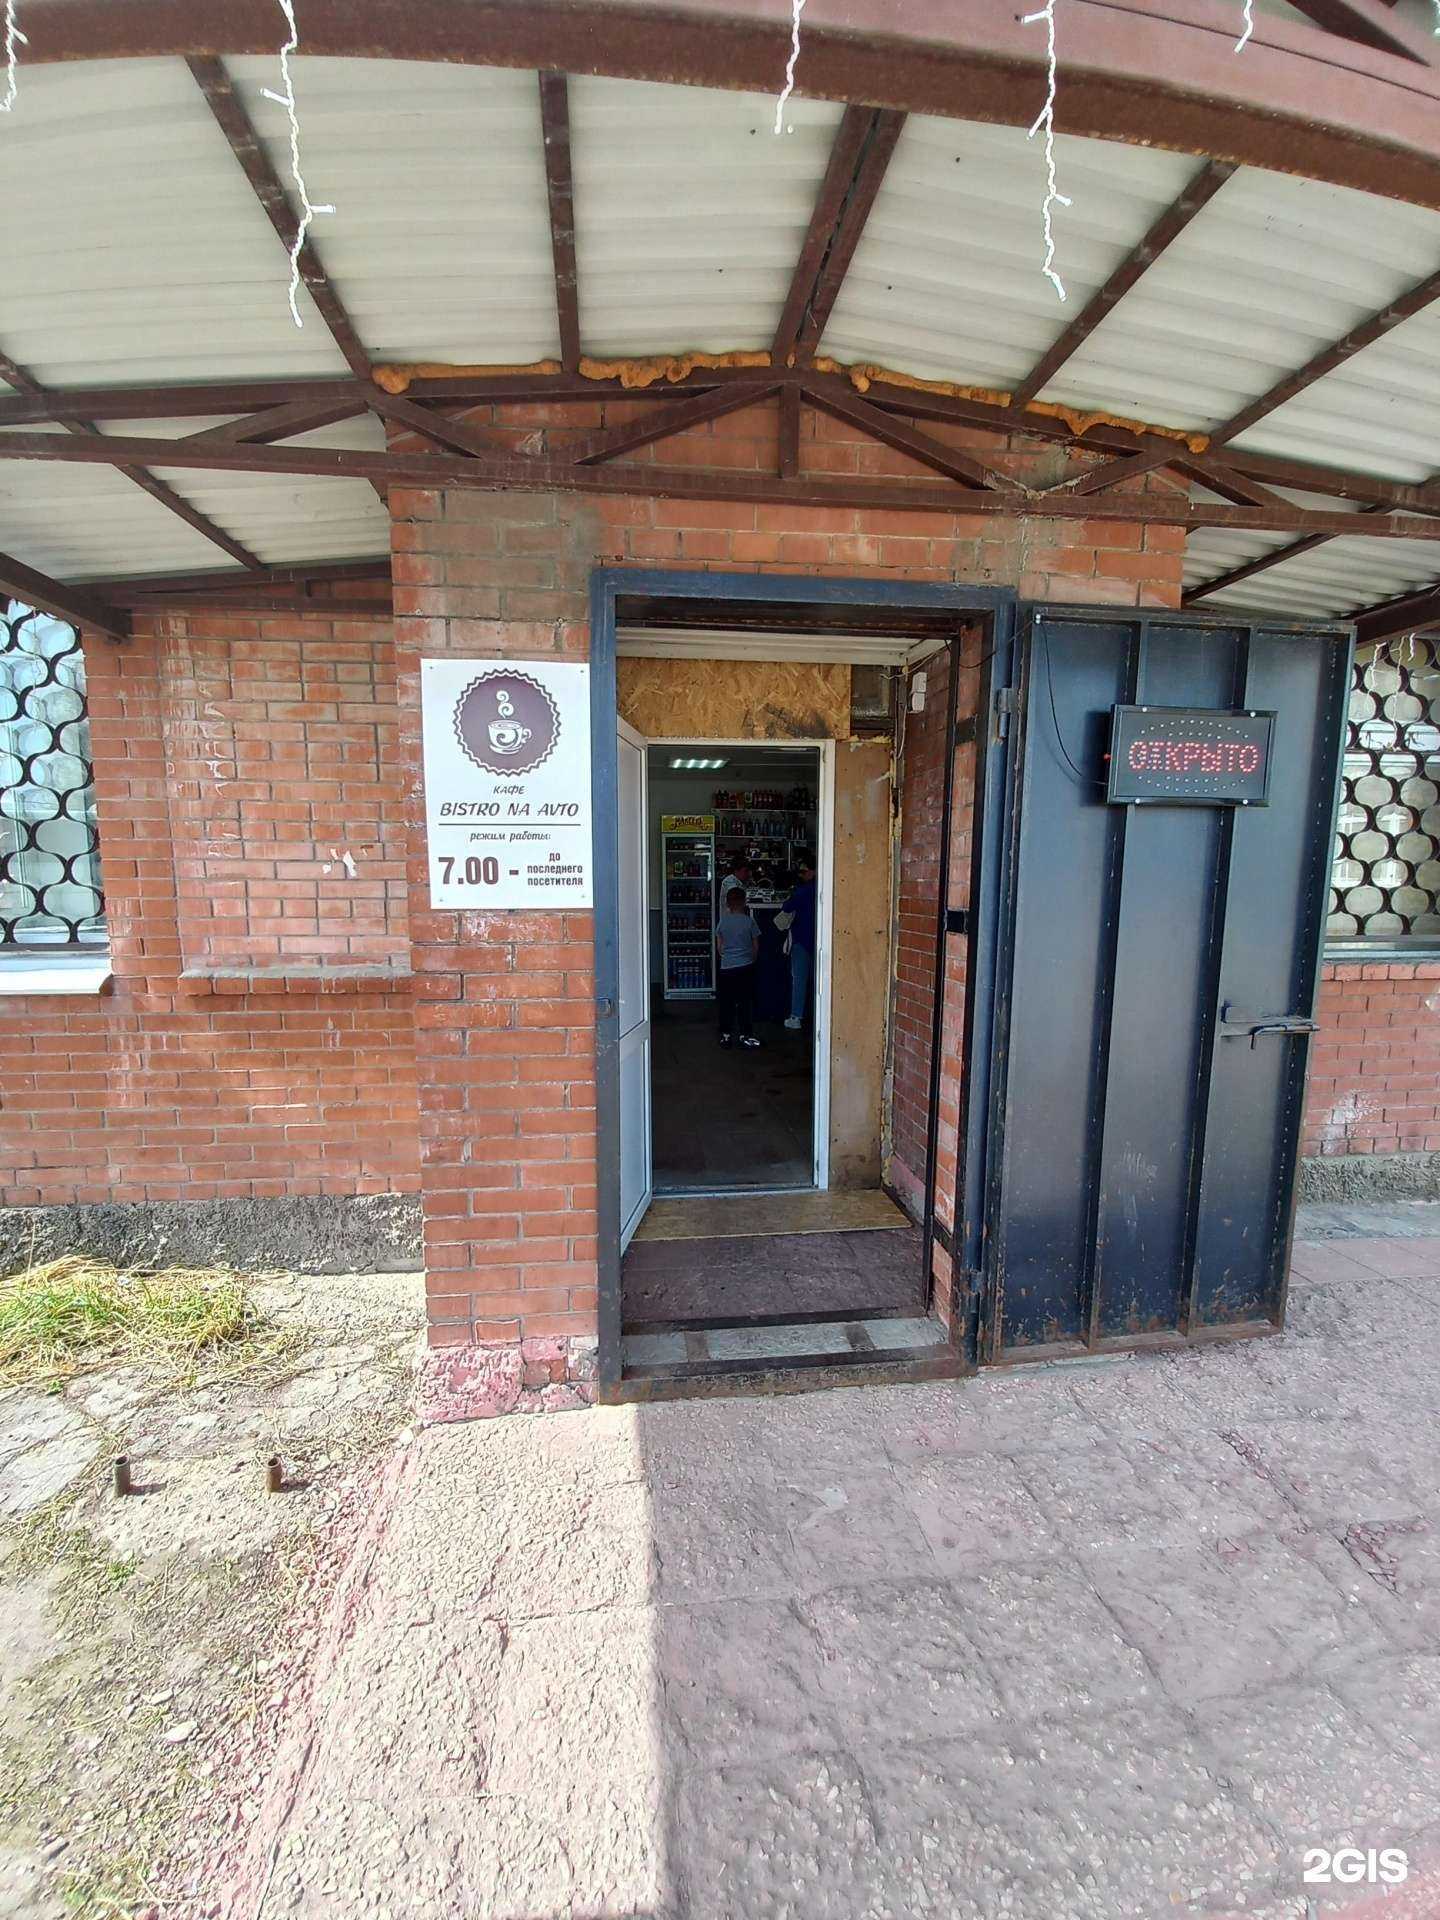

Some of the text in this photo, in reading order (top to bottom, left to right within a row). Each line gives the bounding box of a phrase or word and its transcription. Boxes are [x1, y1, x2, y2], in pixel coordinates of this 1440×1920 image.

[493, 784, 526, 795] КАФЕ
[440, 802, 579, 817] BISTRO NA AVTO
[469, 832, 506, 842] режим
[548, 852, 561, 862] до
[438, 856, 499, 885] 7.00
[527, 864, 583, 873] последнего
[527, 877, 583, 886] посетителя
